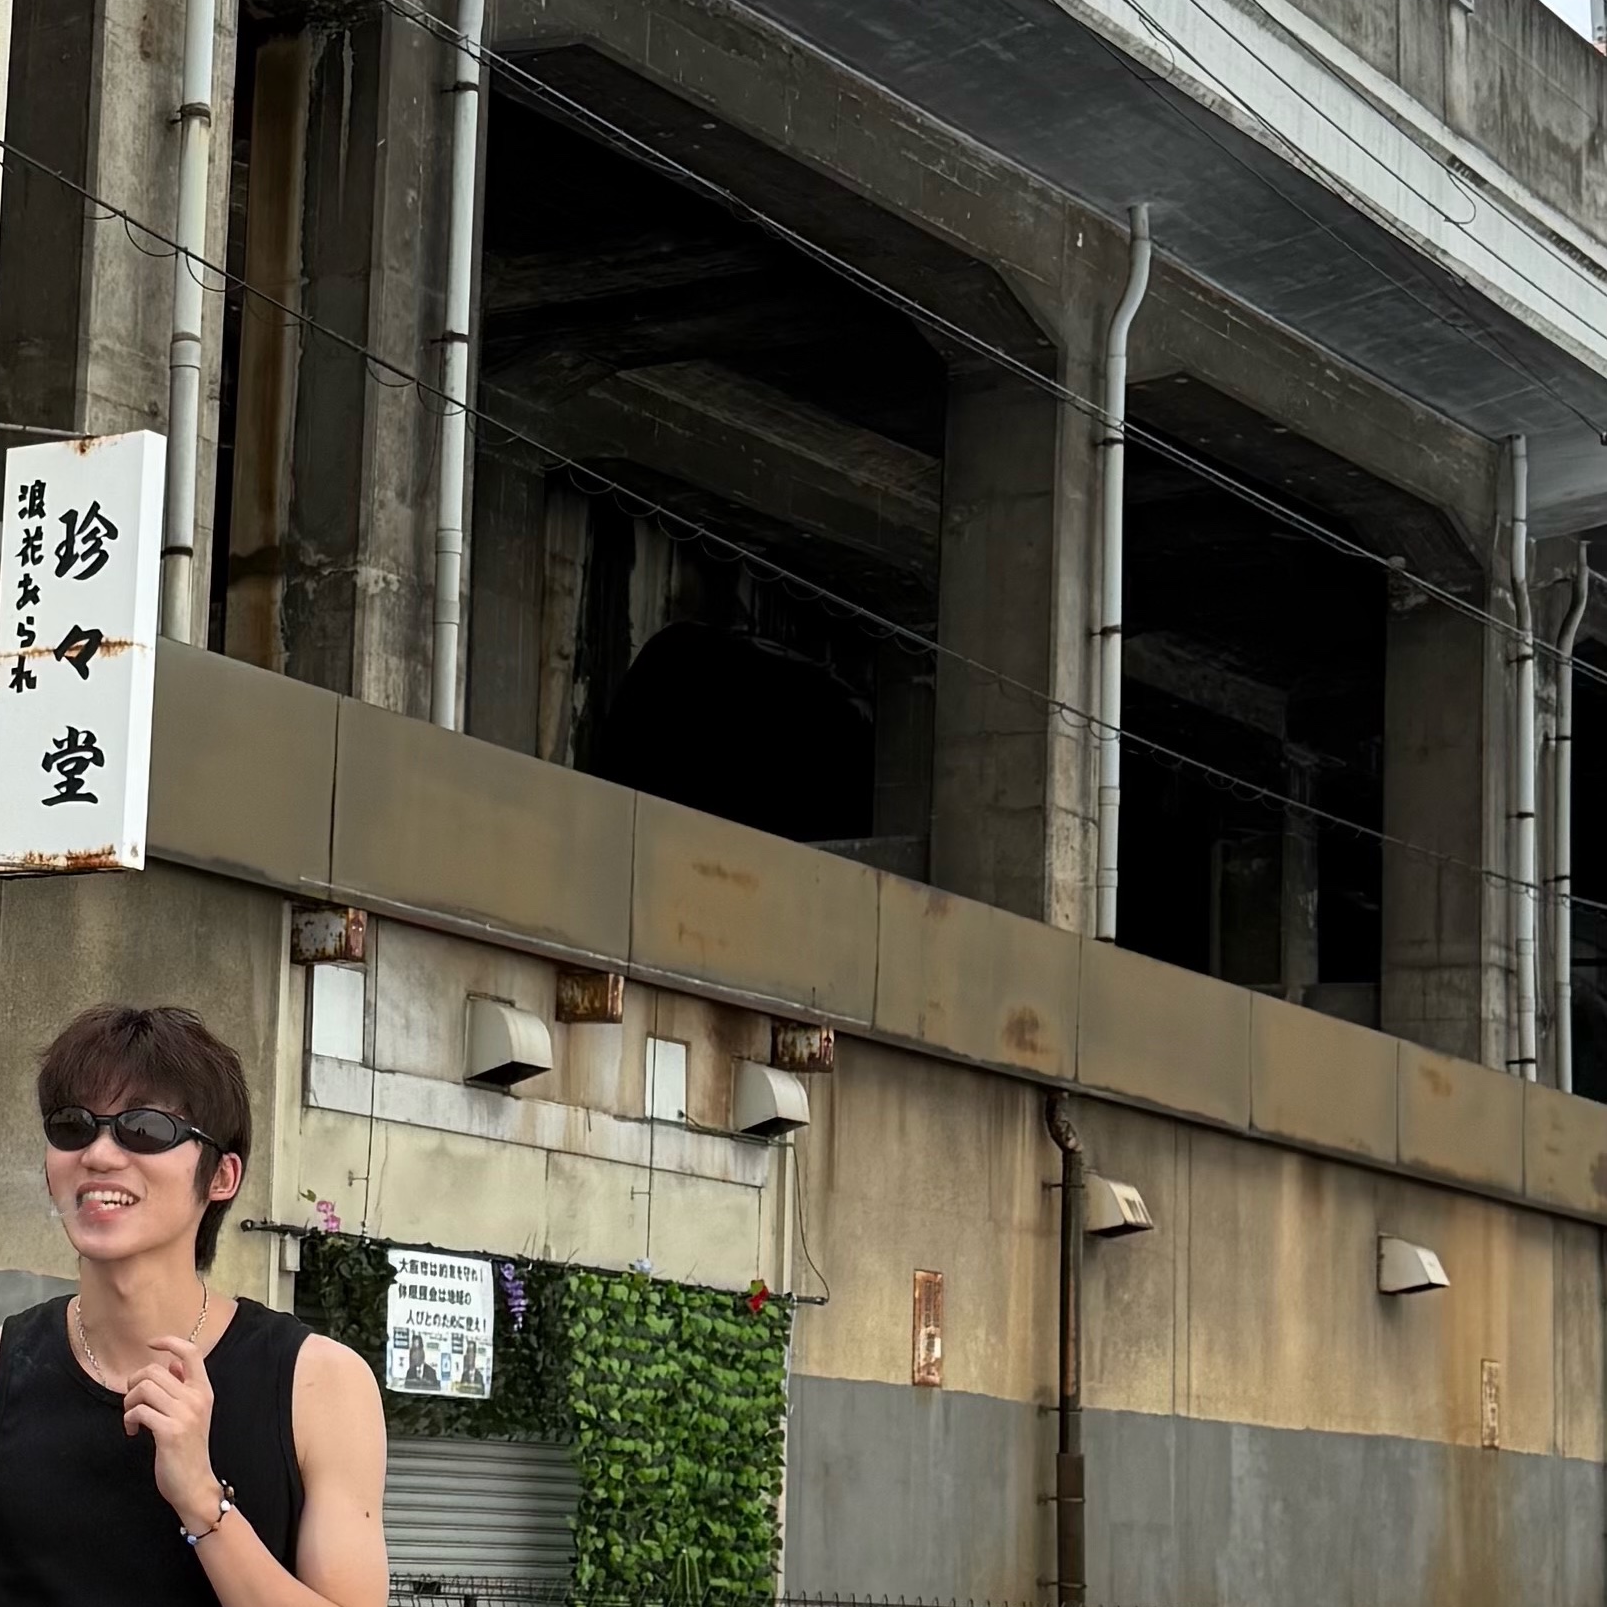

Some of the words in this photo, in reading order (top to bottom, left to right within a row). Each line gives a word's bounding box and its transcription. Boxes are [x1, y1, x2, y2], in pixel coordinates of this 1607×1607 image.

[8, 479, 47, 693] 浪花あられ
[40, 500, 119, 807] 珍々堂
